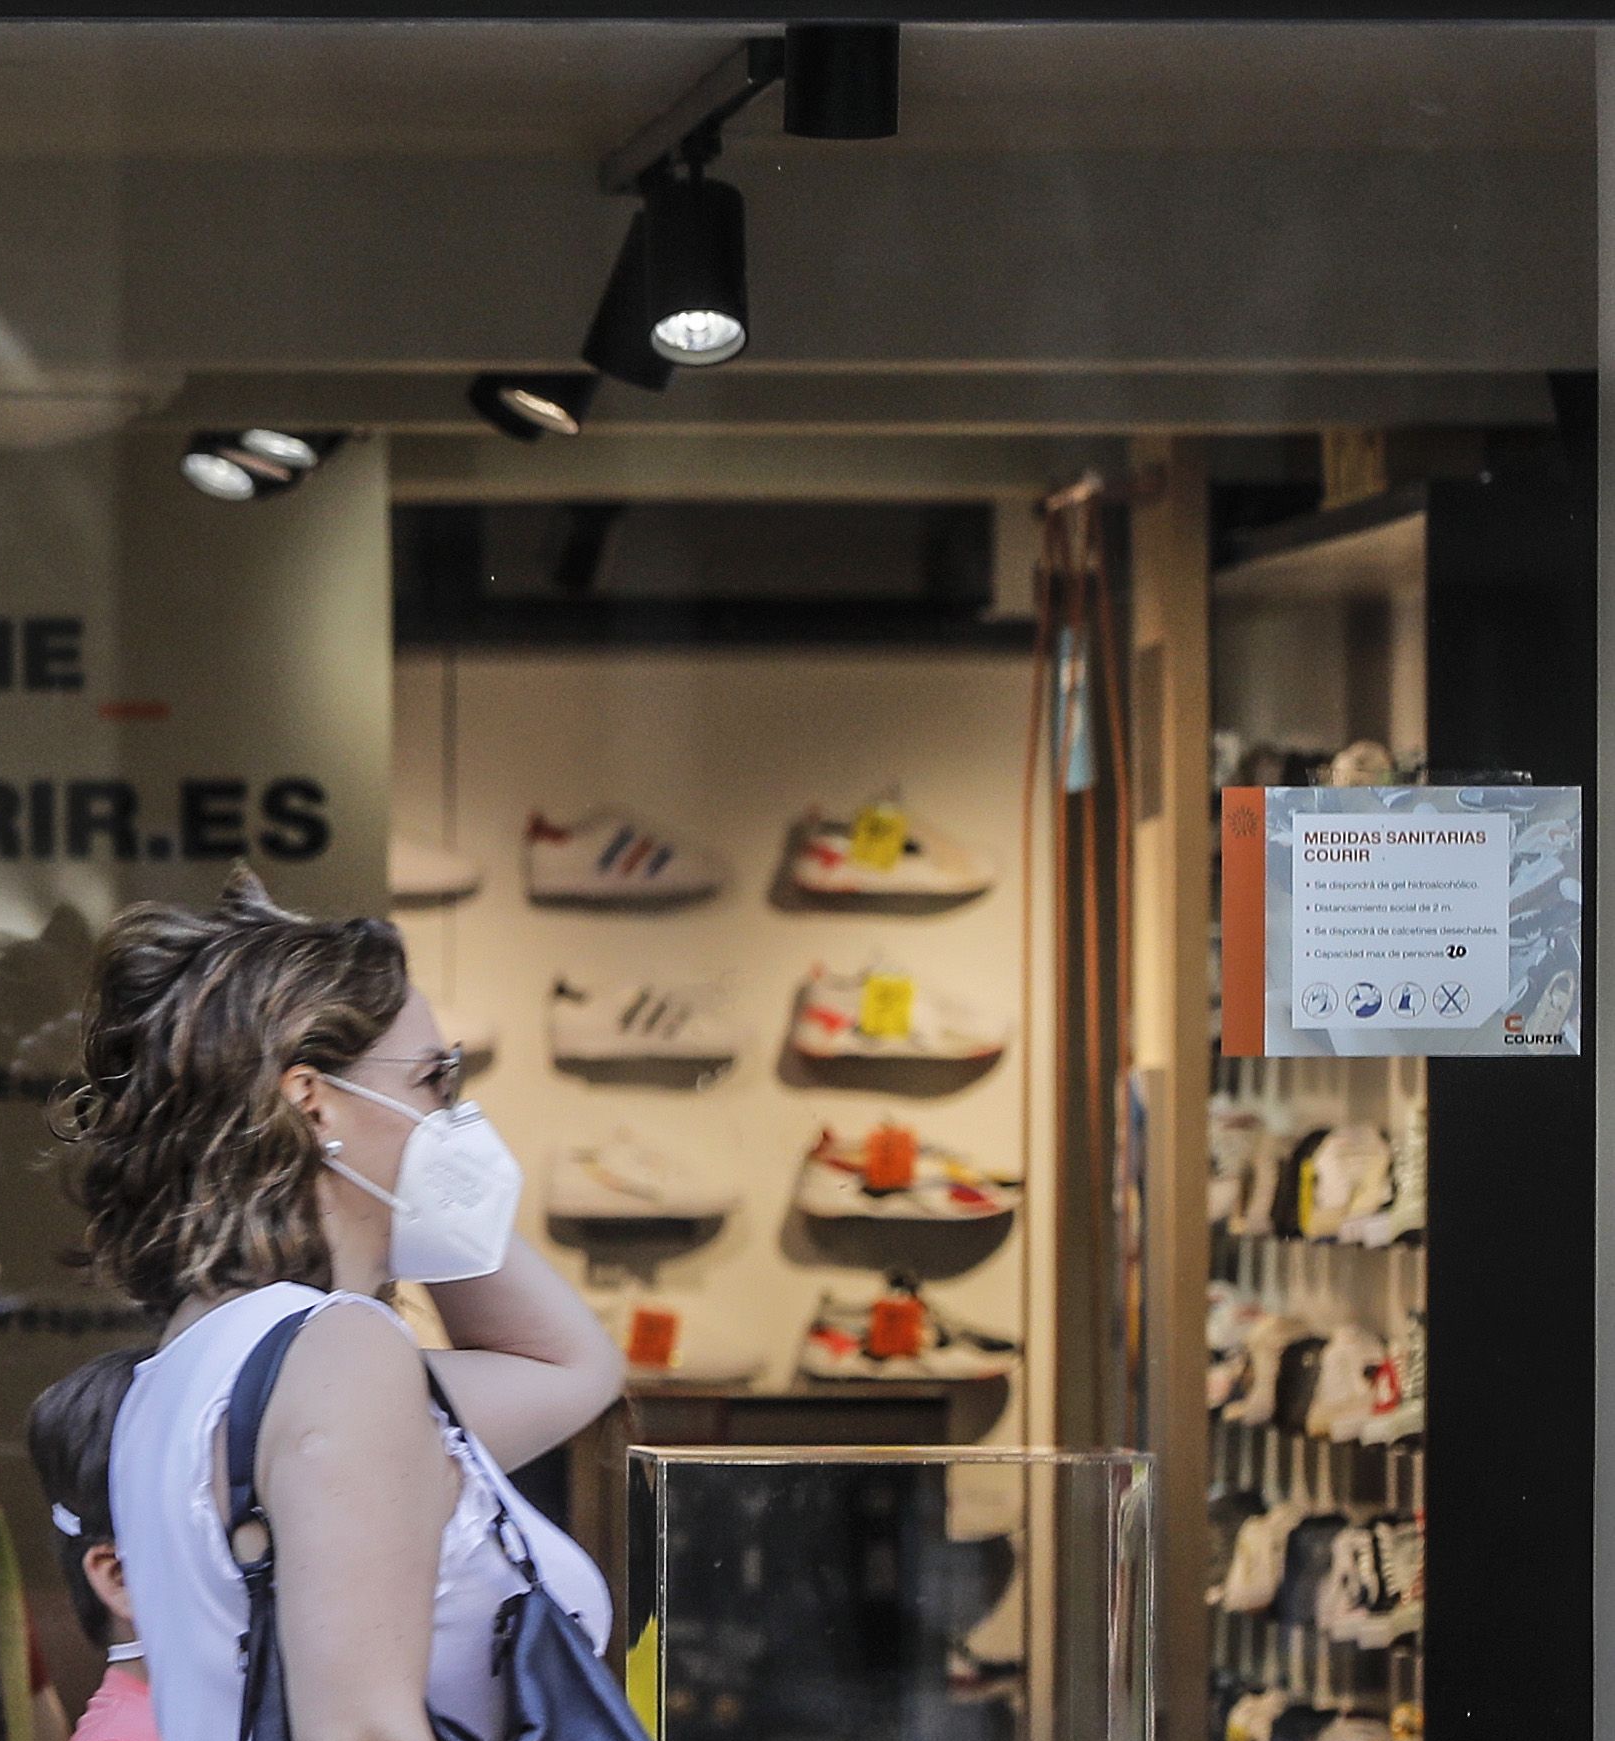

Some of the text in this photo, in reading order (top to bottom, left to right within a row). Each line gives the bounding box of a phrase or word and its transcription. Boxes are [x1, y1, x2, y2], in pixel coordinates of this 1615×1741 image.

[1304, 830, 1487, 845] MEDIDAS SANITARIAS
[1304, 849, 1371, 863] COURIR
[1390, 903, 1416, 913] social
[1418, 903, 1431, 913] de
[1432, 903, 1439, 913] 2
[1503, 1033, 1563, 1046] COURIR
